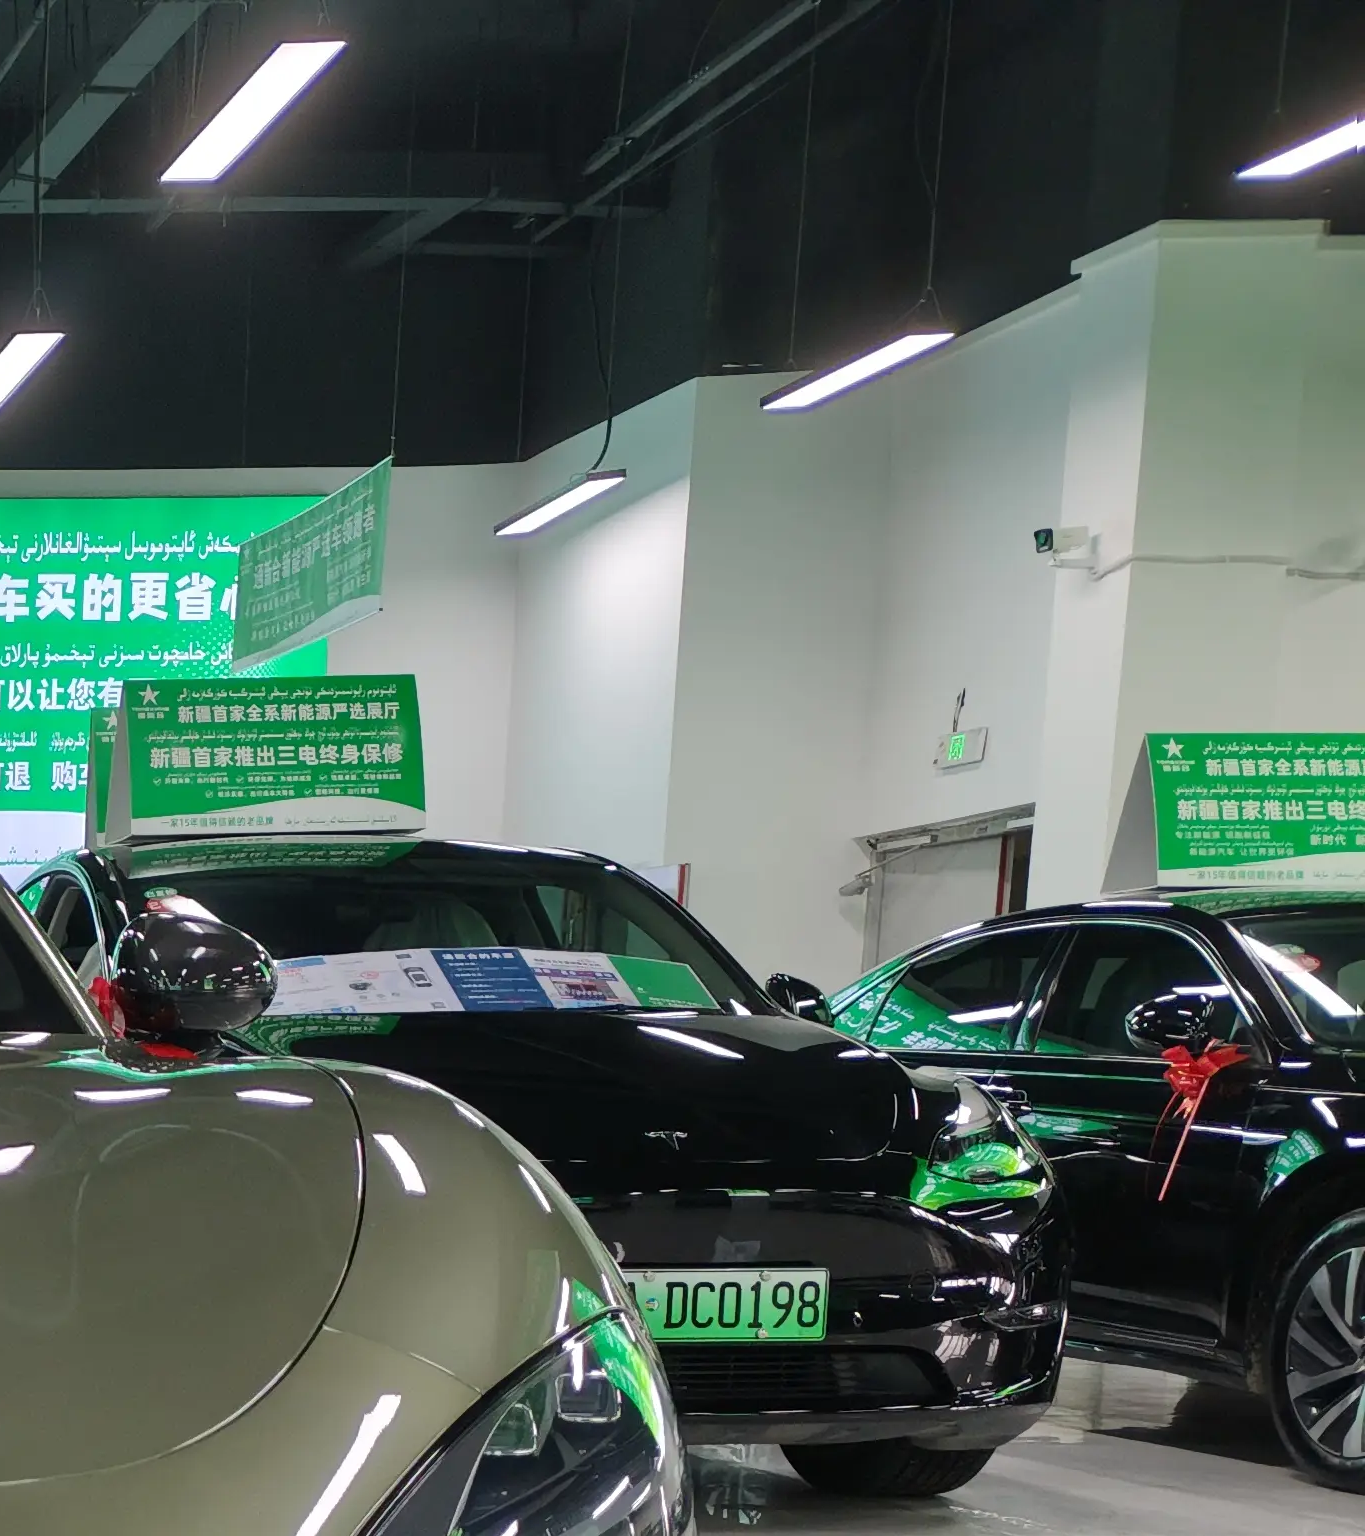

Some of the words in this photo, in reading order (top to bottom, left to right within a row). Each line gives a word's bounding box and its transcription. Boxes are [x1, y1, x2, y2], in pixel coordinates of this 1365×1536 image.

[177, 701, 400, 723] 新疆首家全系新能源严选展厅
[149, 742, 404, 769] 新疆首家推出三电终身保修
[1205, 758, 1365, 777] 新疆首家全系新能源
